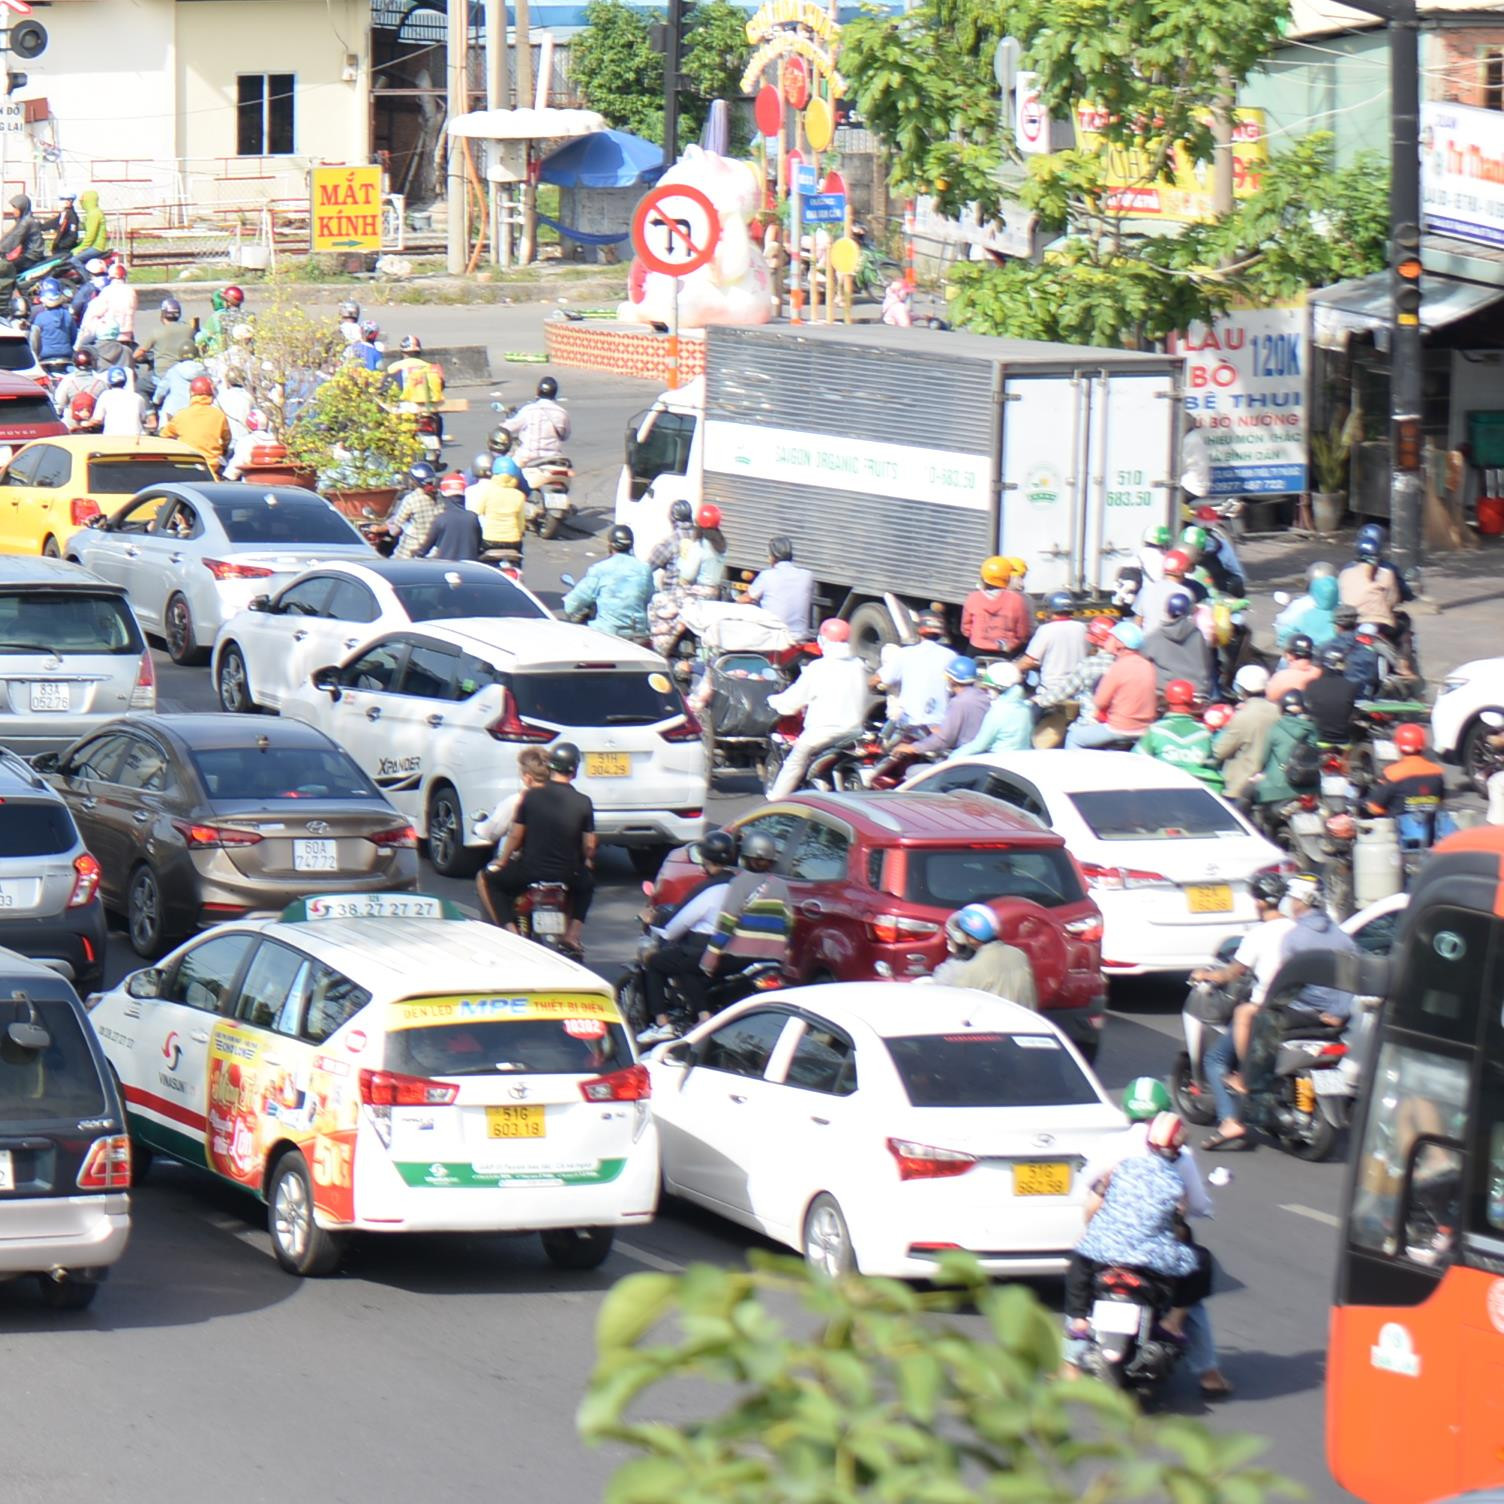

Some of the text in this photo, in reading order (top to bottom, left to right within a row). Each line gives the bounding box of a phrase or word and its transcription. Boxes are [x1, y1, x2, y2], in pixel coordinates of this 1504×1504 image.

[319, 171, 376, 205] MẮT
[318, 209, 379, 237] KÍNH
[1250, 332, 1301, 377] 120K
[1189, 358, 1238, 388] BÒ
[1228, 391, 1301, 409] THUI
[1106, 491, 1152, 506] 683.50
[304, 841, 327, 854] 60A
[337, 903, 434, 916] 38.27 27 27
[431, 1004, 453, 1016] LED
[459, 997, 529, 1017] MPE
[158, 1071, 188, 1094] VINASUN
